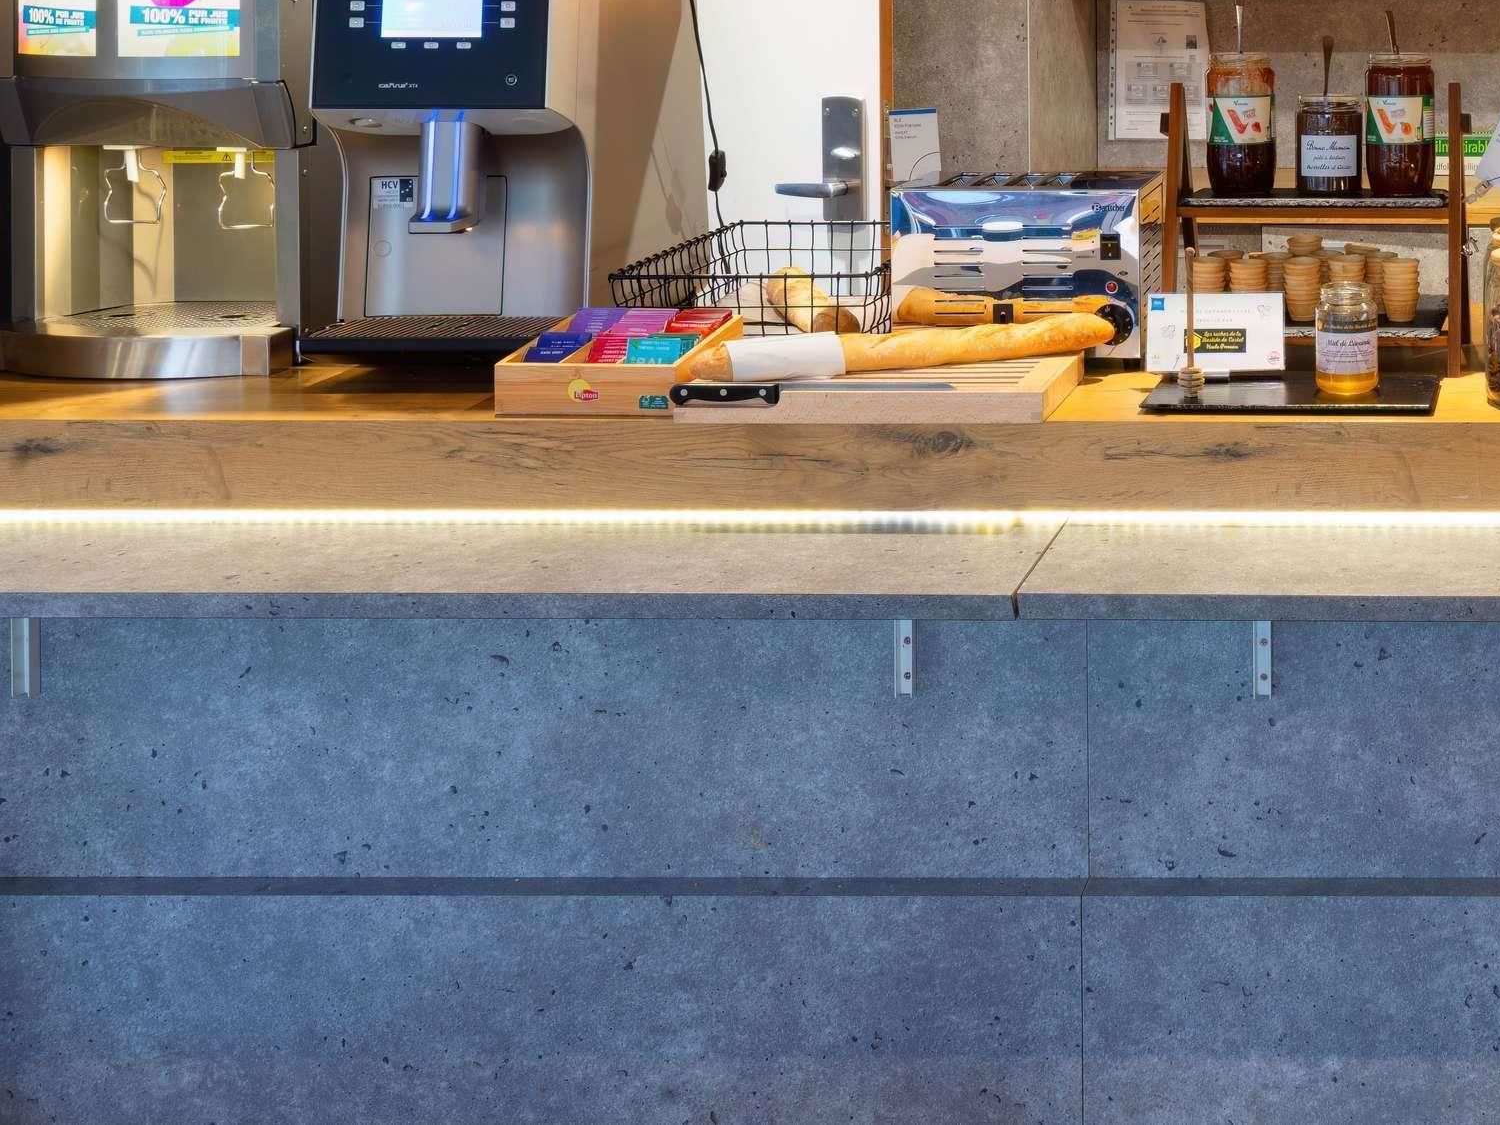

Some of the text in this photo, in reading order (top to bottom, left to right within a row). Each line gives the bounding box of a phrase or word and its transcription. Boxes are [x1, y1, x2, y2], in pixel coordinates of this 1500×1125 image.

[29, 8, 54, 24] 100%
[142, 8, 186, 24] 100%
[574, 390, 599, 401] Lipton
